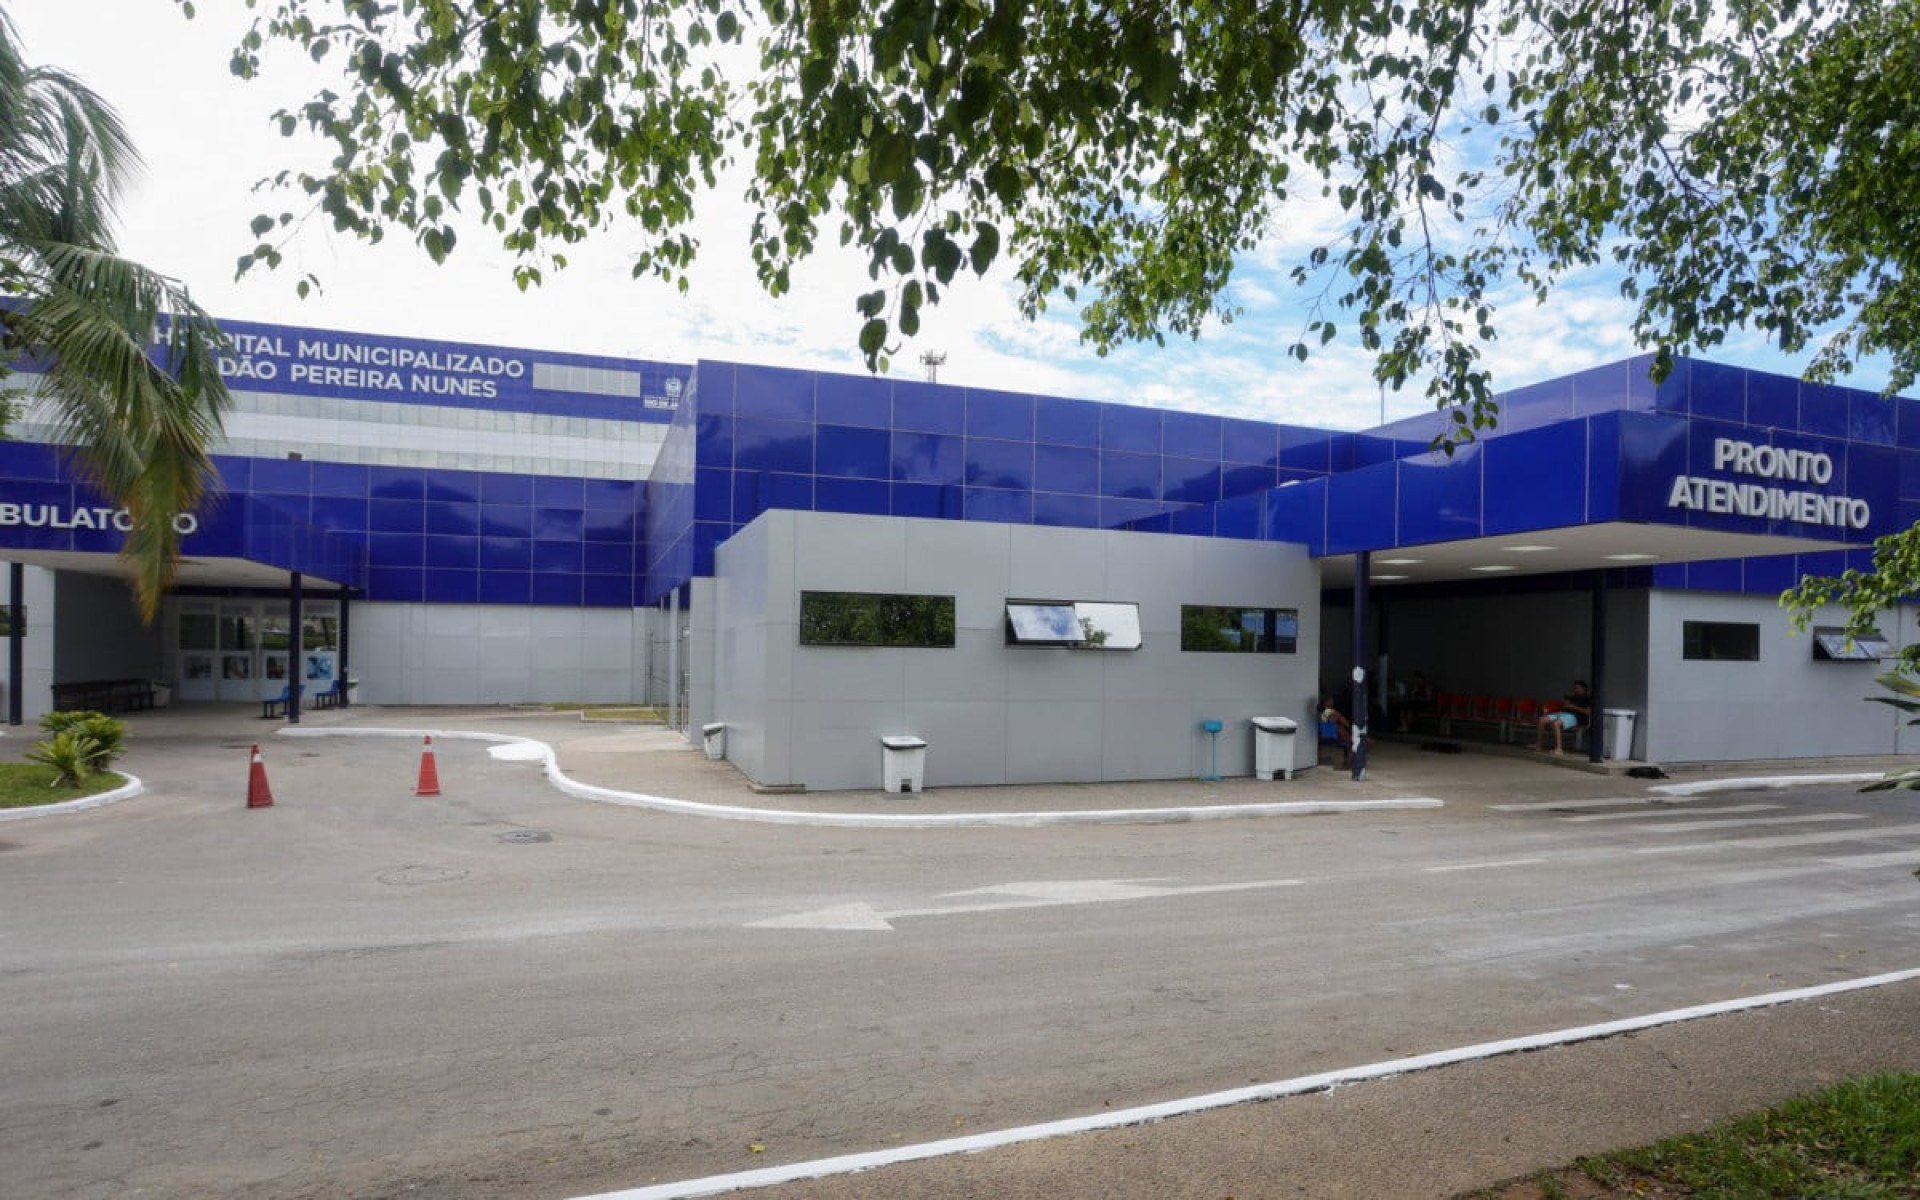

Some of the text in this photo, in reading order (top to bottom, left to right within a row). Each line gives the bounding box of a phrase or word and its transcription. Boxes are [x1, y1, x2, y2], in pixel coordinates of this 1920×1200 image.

[153, 326, 524, 378] HSPITAL MUNICIPALIZADO
[215, 354, 497, 398] DÃO PEREIRA NUNES
[1714, 437, 1832, 485] PRONTO
[1668, 475, 1870, 529] ATENDIMENTO
